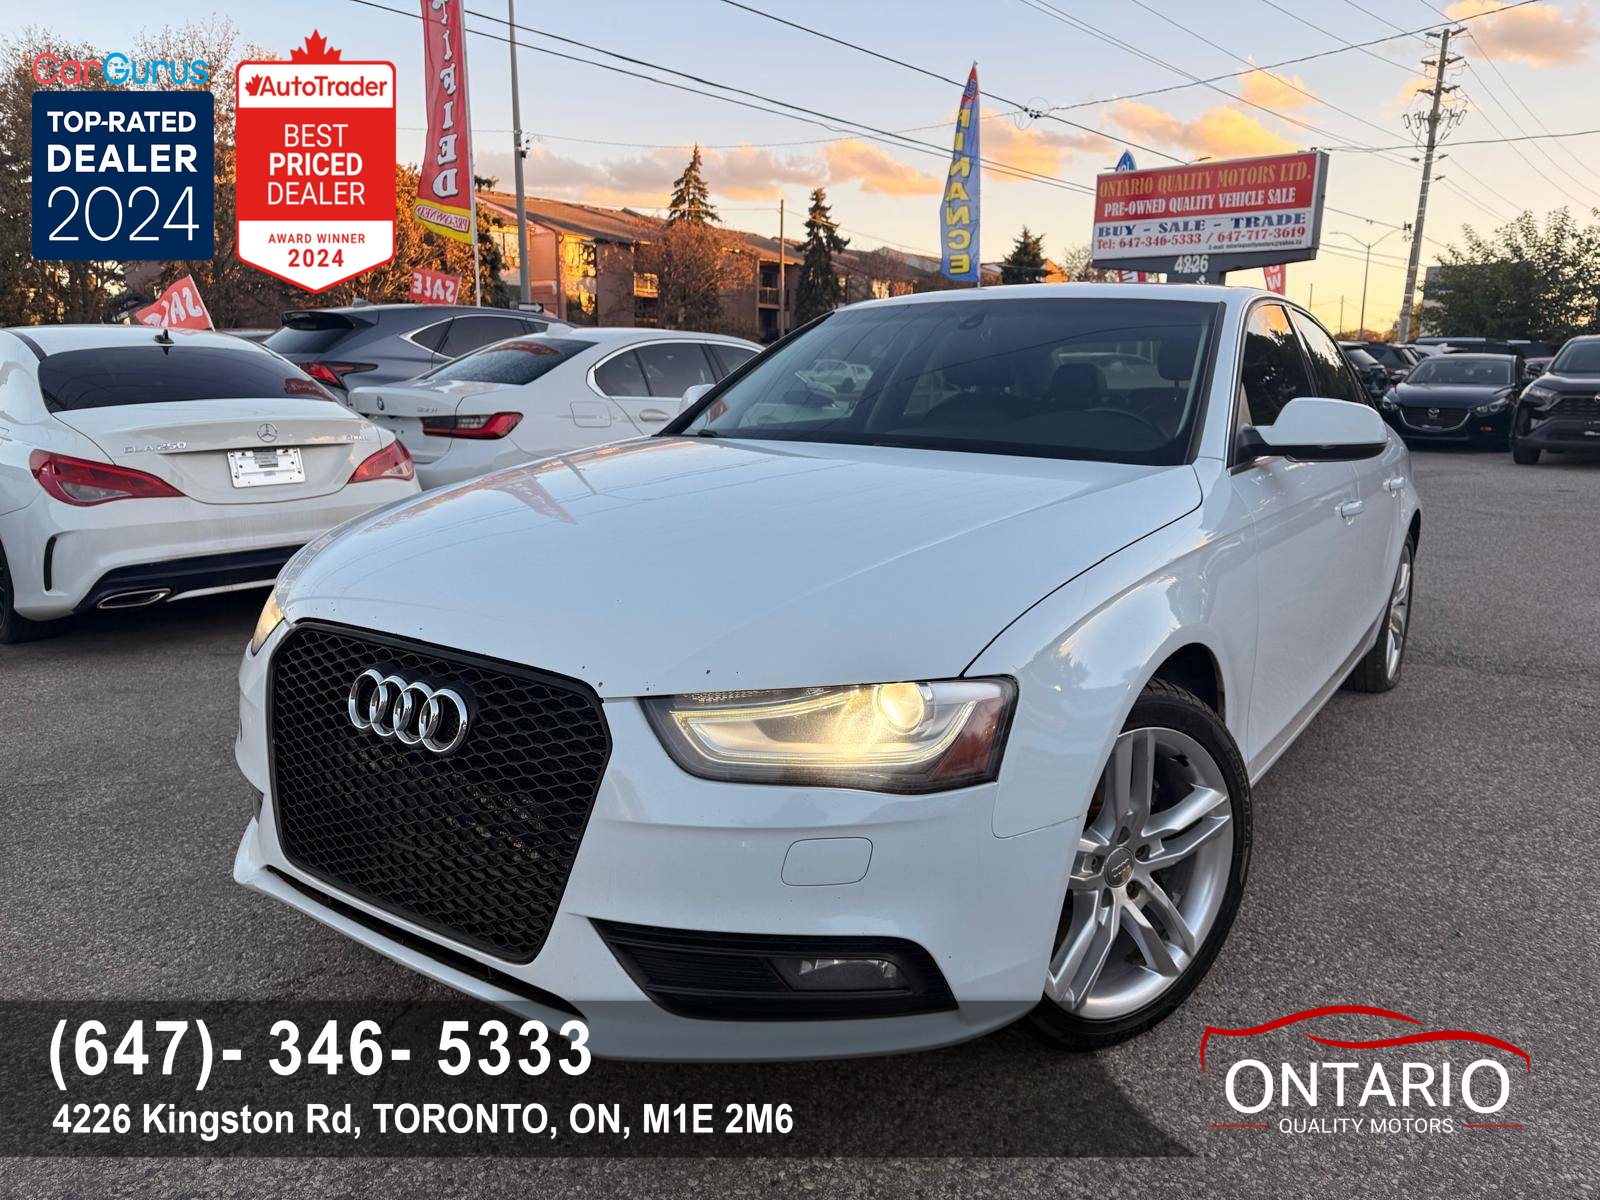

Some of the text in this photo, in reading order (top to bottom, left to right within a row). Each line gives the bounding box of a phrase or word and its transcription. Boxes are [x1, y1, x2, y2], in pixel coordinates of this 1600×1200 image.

[1100, 161, 1312, 198] ONTARIO QUALITY MOTORS LTD.
[1104, 187, 1296, 217] PRE-OWNED QUALITY VEHICLE SALE
[1098, 225, 1136, 237] BUY
[1158, 219, 1206, 234] SALE
[1230, 212, 1306, 229] TRADE
[1097, 238, 1116, 249] Tel:
[1118, 232, 1202, 248] 647-346-5333
[1217, 226, 1306, 242] 647-717-3619
[1174, 254, 1209, 274] 4226
